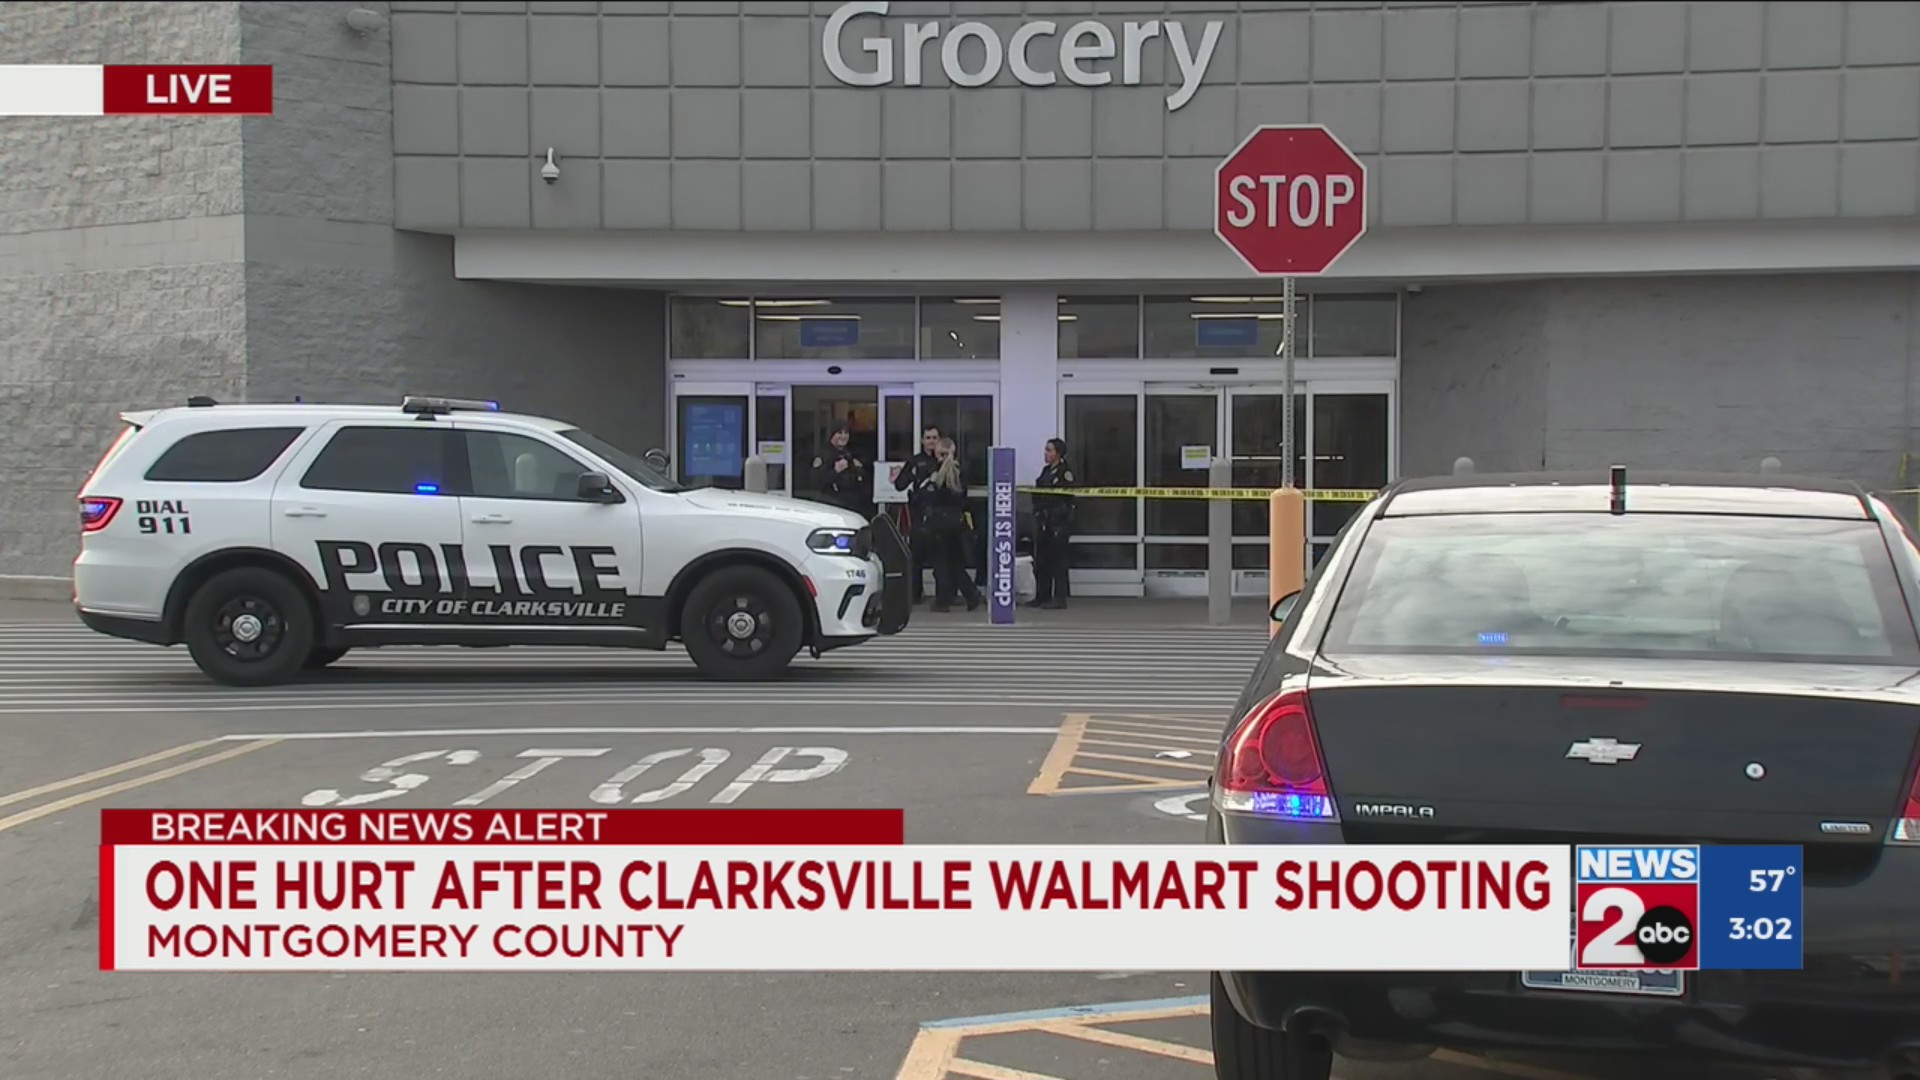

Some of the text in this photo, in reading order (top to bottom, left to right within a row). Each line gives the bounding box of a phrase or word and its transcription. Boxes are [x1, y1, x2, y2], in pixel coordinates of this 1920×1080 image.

[823, 1, 1223, 111] Grocery
[1227, 174, 1355, 228] STOP
[136, 500, 189, 513] DIAL
[138, 516, 191, 534] 911
[995, 521, 1012, 537] IS
[315, 540, 627, 595] POLICE
[994, 541, 1012, 607] claire's
[381, 599, 626, 618] CITY OF CLARKSVILLE
[302, 747, 849, 805] STOP
[1355, 804, 1435, 819] IMPALA
[1564, 975, 1638, 988] MONTGOMERY
